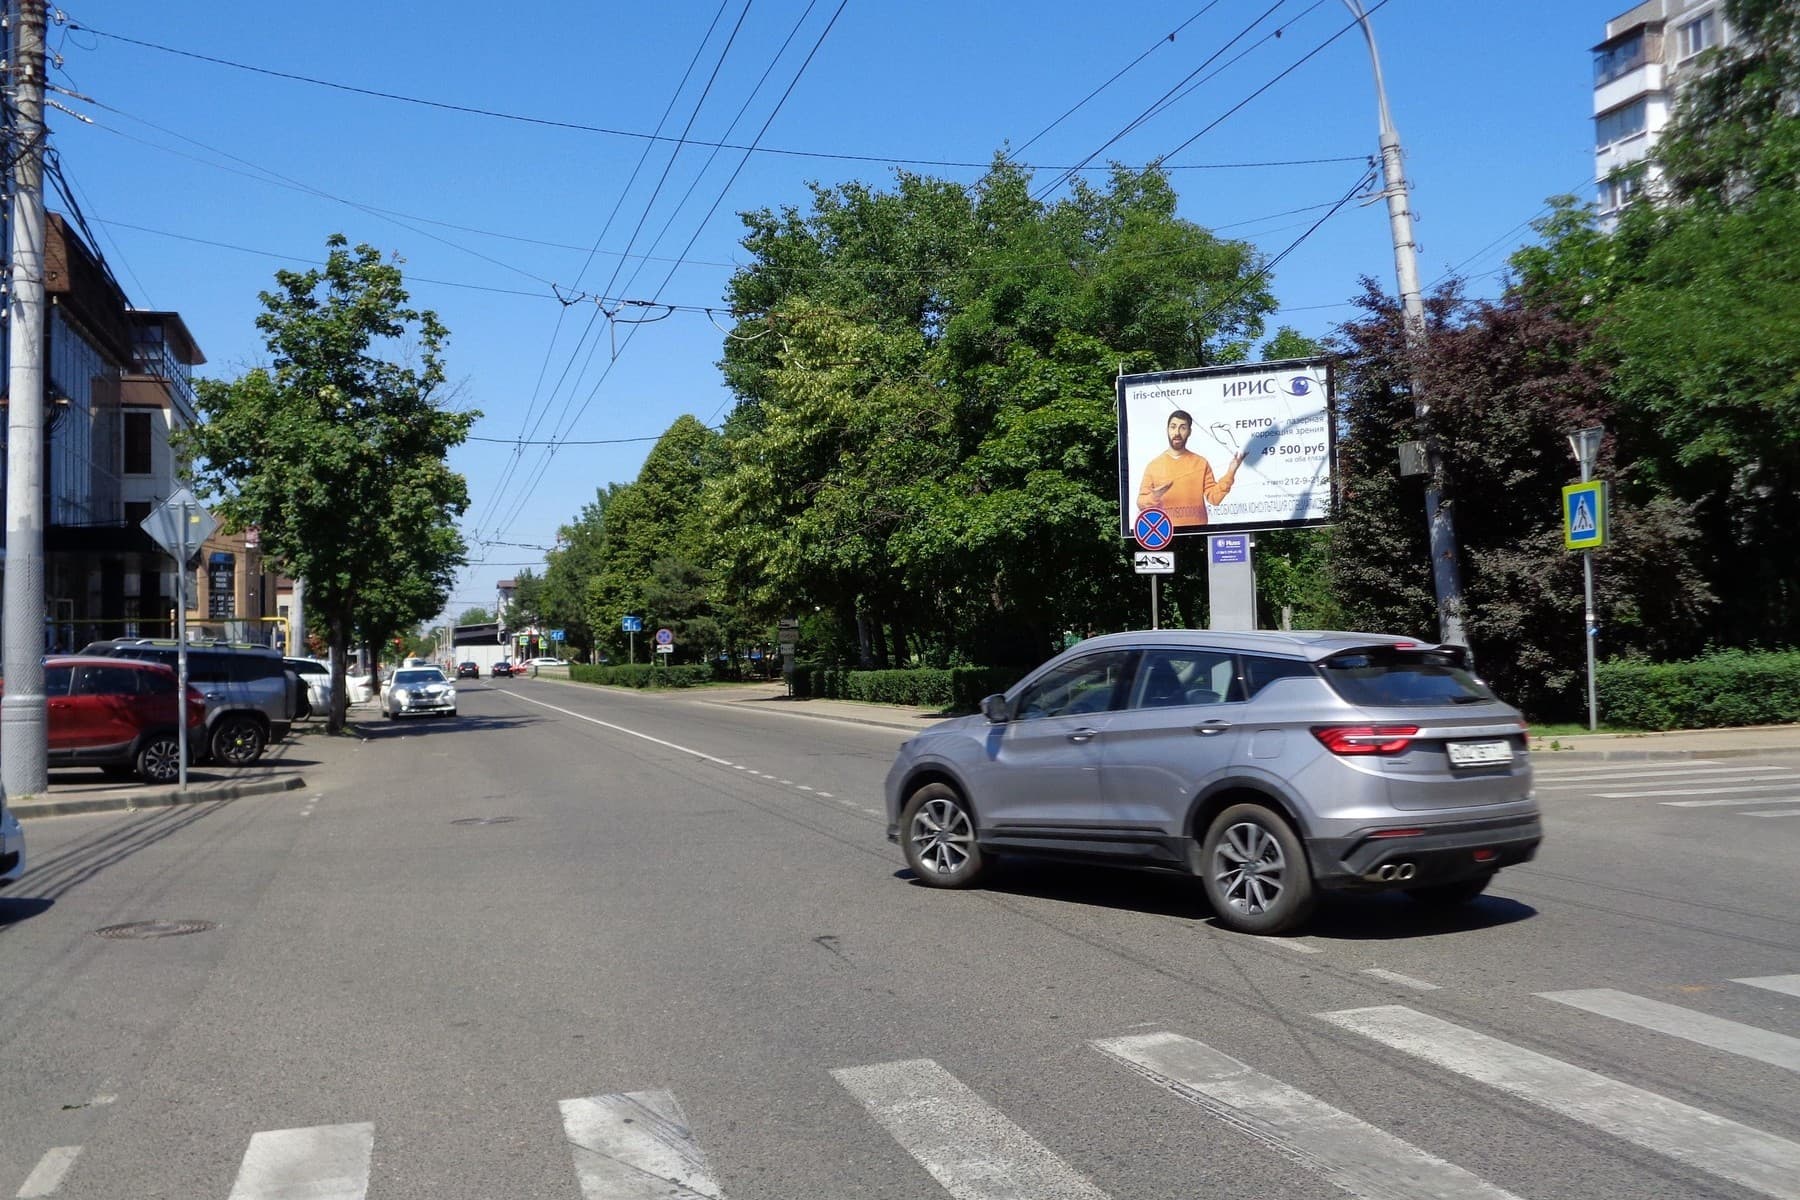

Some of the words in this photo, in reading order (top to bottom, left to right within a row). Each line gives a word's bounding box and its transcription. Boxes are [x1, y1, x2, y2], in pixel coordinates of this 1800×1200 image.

[1133, 388, 1193, 400] iris-center.ru
[1223, 378, 1276, 398] ИРИС
[1251, 428, 1294, 439] коррекция
[1296, 427, 1324, 436] зрения
[1261, 446, 1276, 456] 49
[1279, 444, 1301, 455] 500
[1304, 442, 1325, 455] руб
